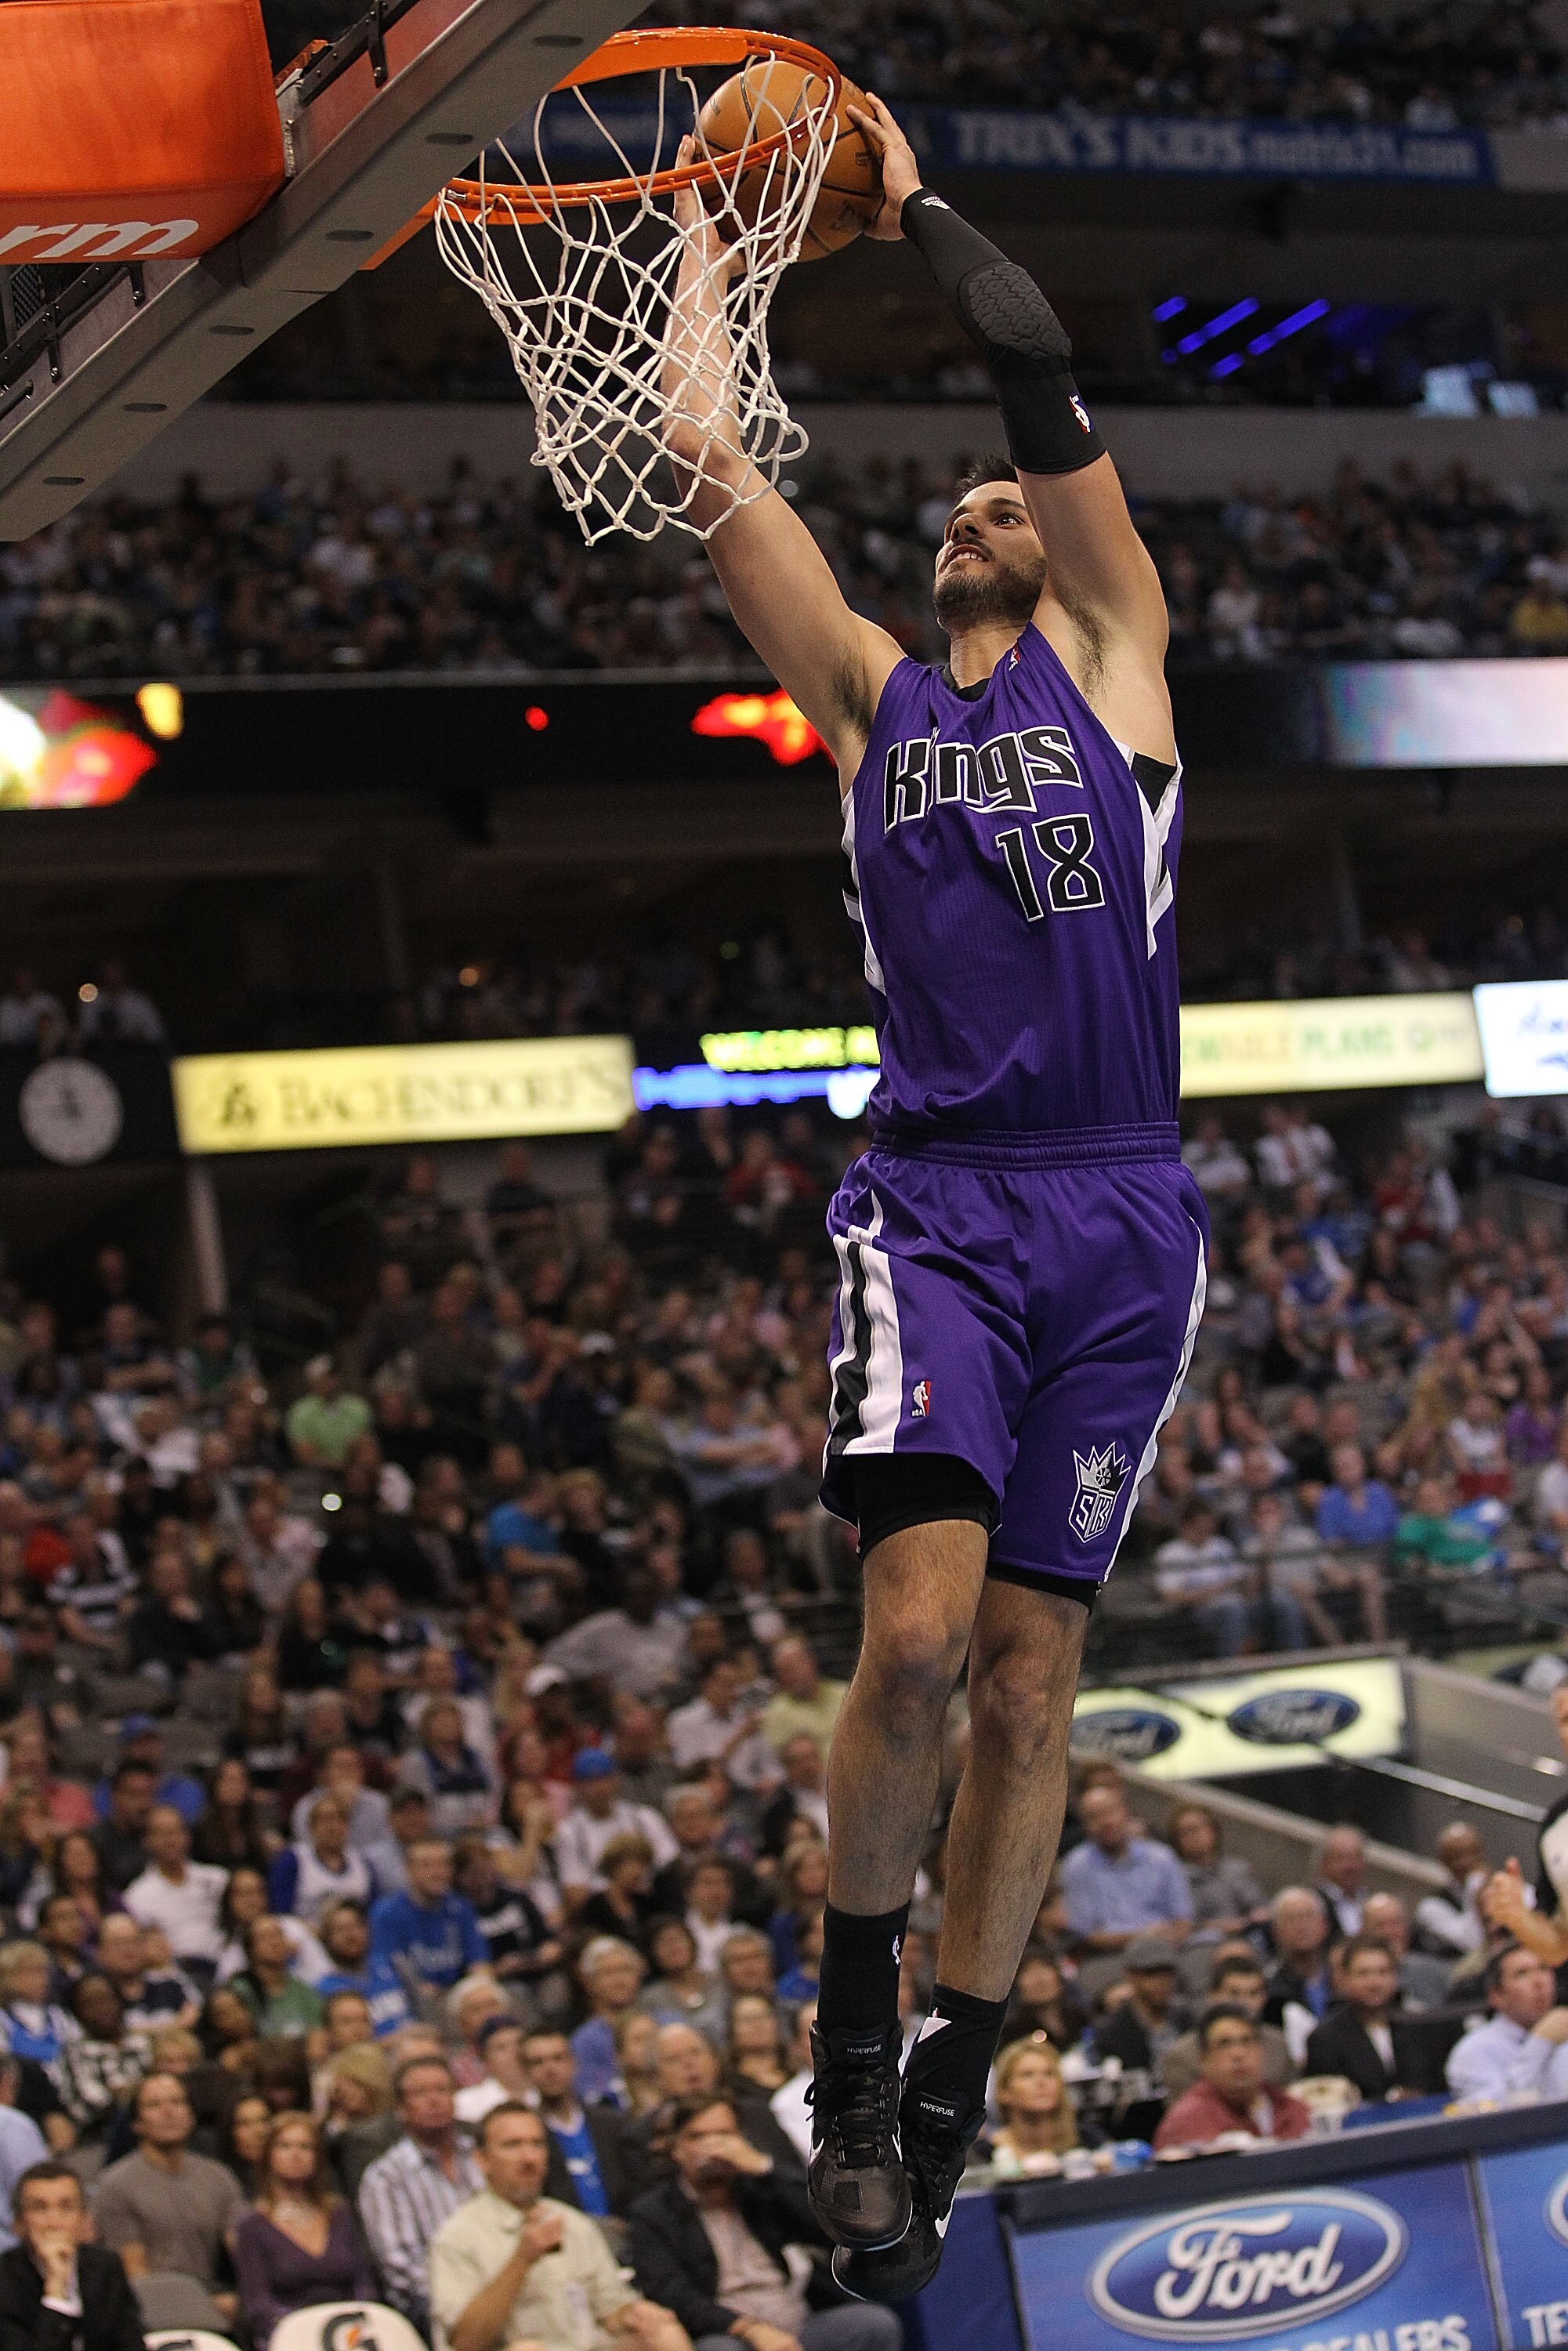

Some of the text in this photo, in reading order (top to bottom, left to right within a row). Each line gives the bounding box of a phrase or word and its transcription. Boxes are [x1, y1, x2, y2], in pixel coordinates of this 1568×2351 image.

[994, 813, 1106, 923] 18
[920, 2101, 955, 2117] HYPERFUSE
[1153, 2212, 1344, 2318] Ford
